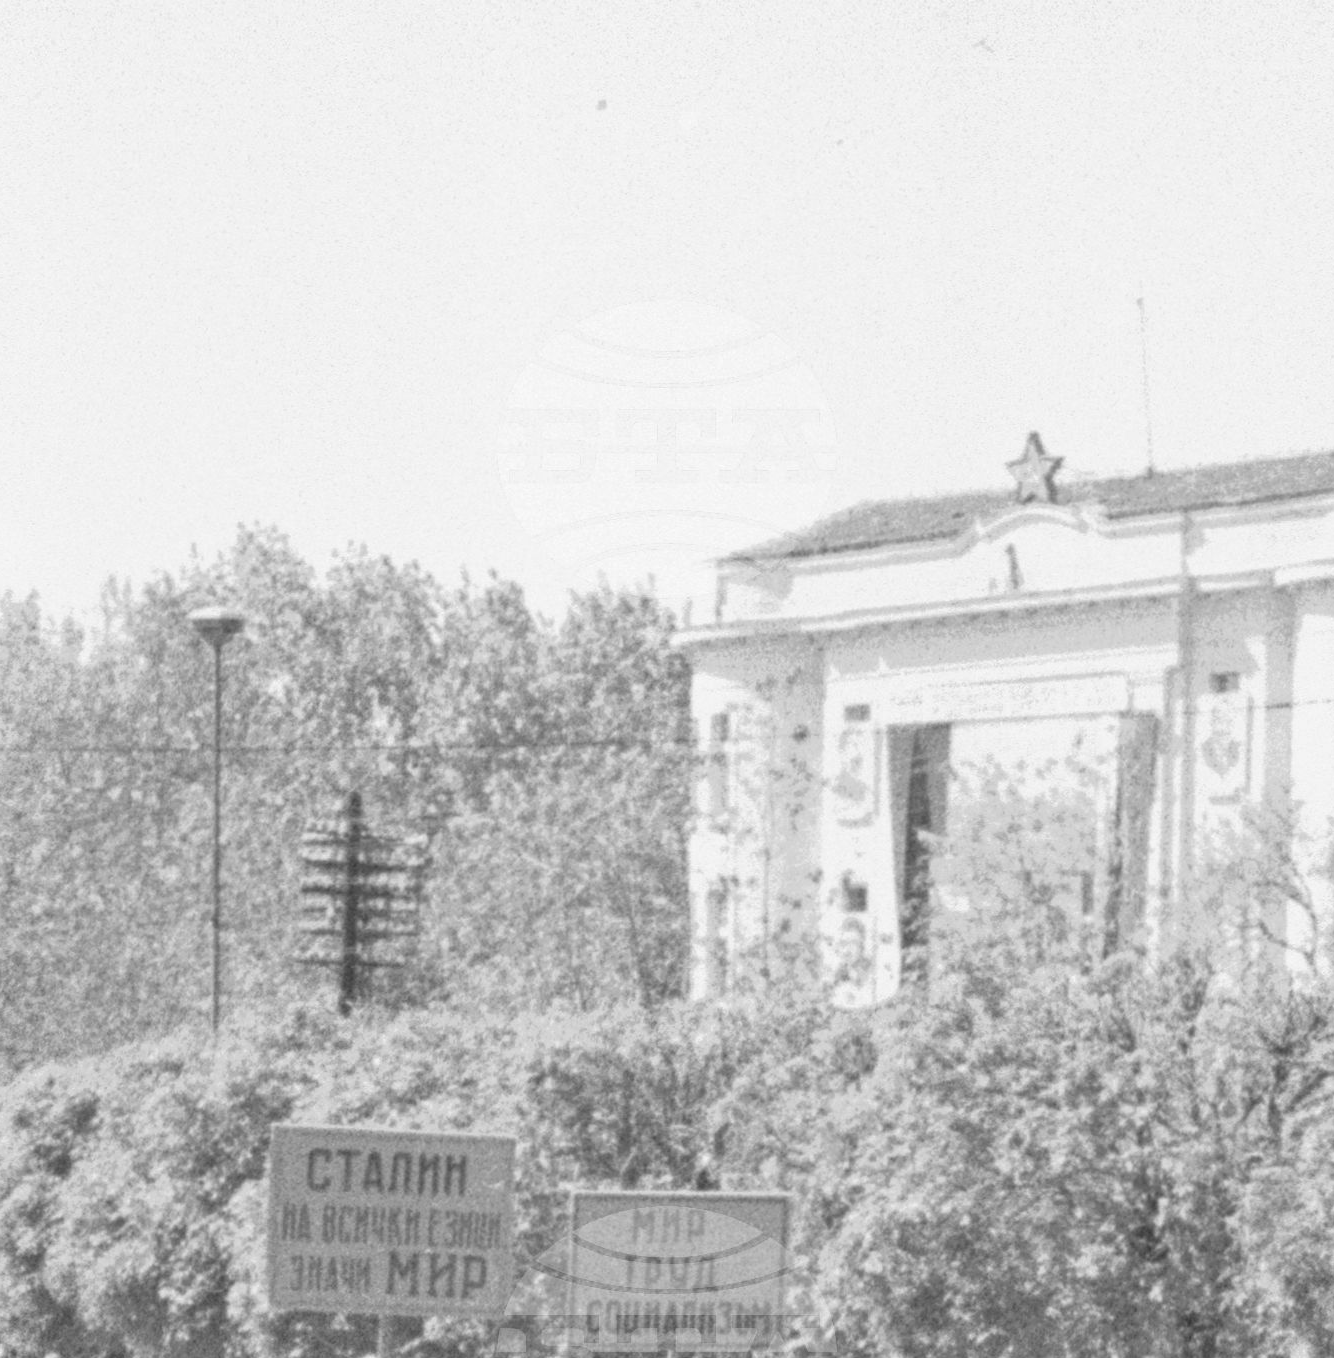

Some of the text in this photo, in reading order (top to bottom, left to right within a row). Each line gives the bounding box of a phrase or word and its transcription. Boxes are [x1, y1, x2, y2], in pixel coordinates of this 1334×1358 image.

[306, 1148, 468, 1197] СТАЛИН
[281, 1202, 311, 1241] НА
[321, 1204, 420, 1246] ВСИЧКИ
[632, 1206, 707, 1244] МИР
[290, 1250, 488, 1300] ЗНАЧИ МИР
